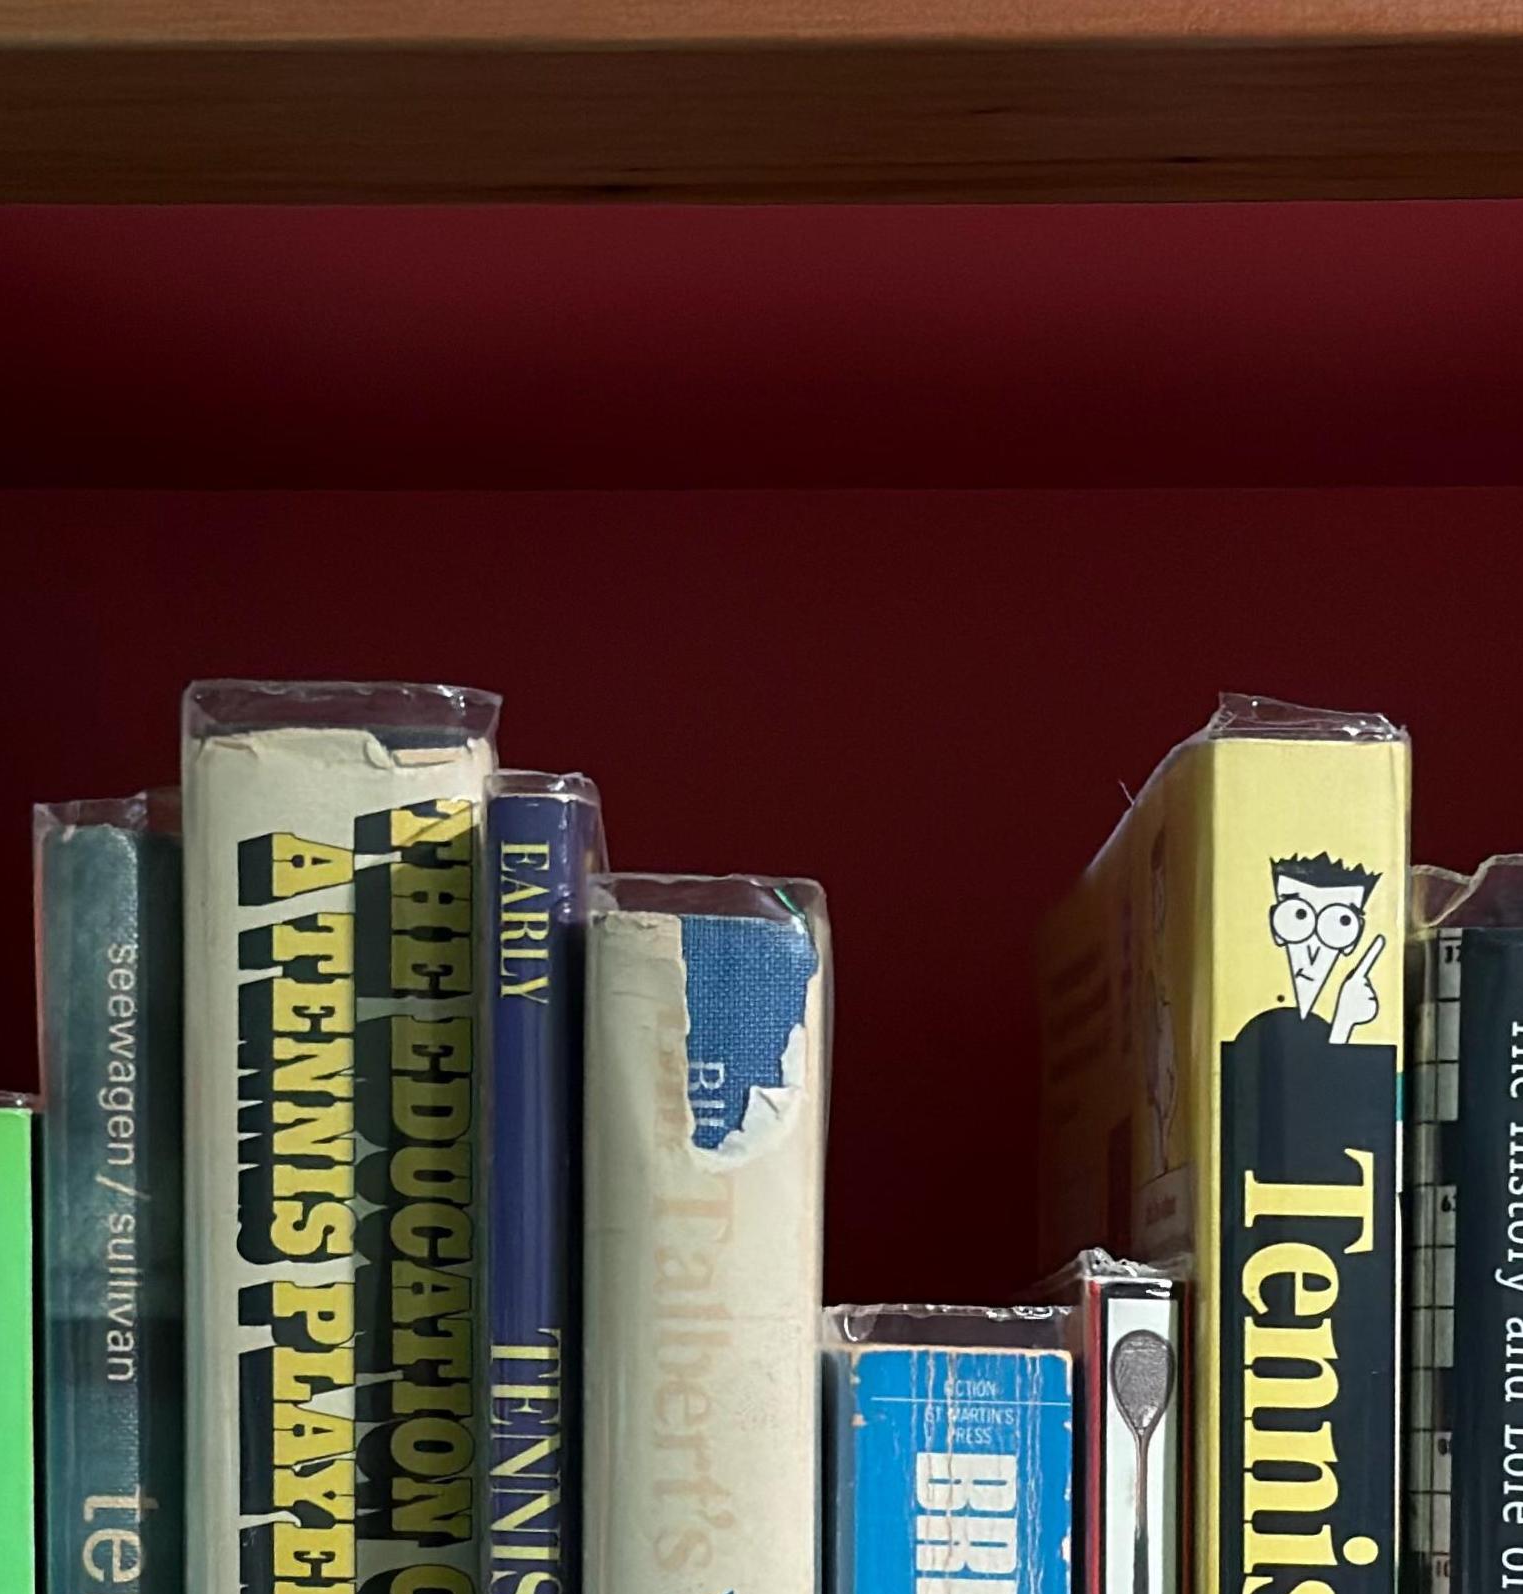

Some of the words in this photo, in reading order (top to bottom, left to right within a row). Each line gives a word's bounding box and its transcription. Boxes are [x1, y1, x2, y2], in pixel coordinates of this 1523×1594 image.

[252, 832, 354, 905] A
[369, 799, 474, 999] THE
[499, 840, 549, 1004] EARLY
[96, 944, 138, 1167] seewagen
[252, 912, 355, 1261] TENNIS
[106, 1213, 145, 1381] sullivan
[372, 1015, 475, 1548] EDUCATION
